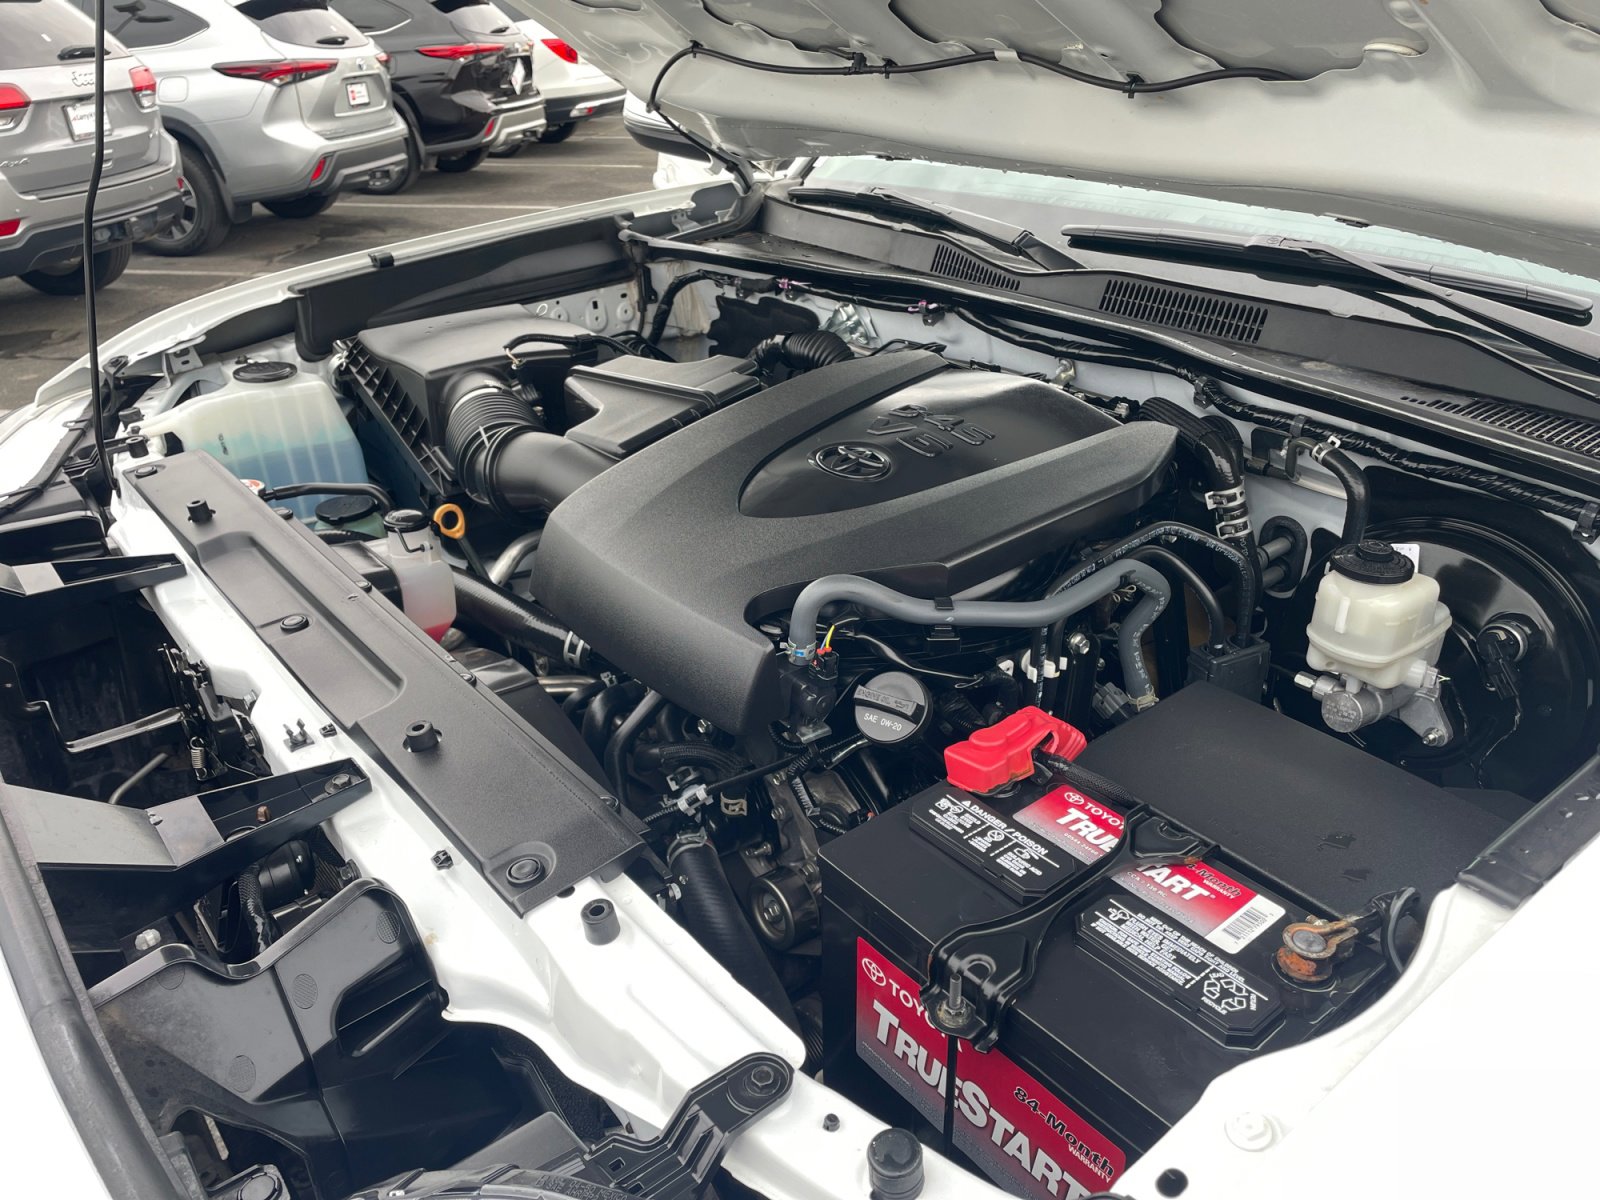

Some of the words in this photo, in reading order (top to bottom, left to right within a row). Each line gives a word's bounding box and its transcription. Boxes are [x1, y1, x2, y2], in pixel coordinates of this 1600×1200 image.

[866, 416, 953, 458] V6
[863, 713, 878, 723] SAE
[880, 718, 902, 731] 0W-20
[1085, 802, 1124, 830] TOYO
[1203, 879, 1235, 899] WARRANTY
[1013, 1086, 1115, 1178] 84-Month
[1068, 1143, 1112, 1184] WARRANTY
